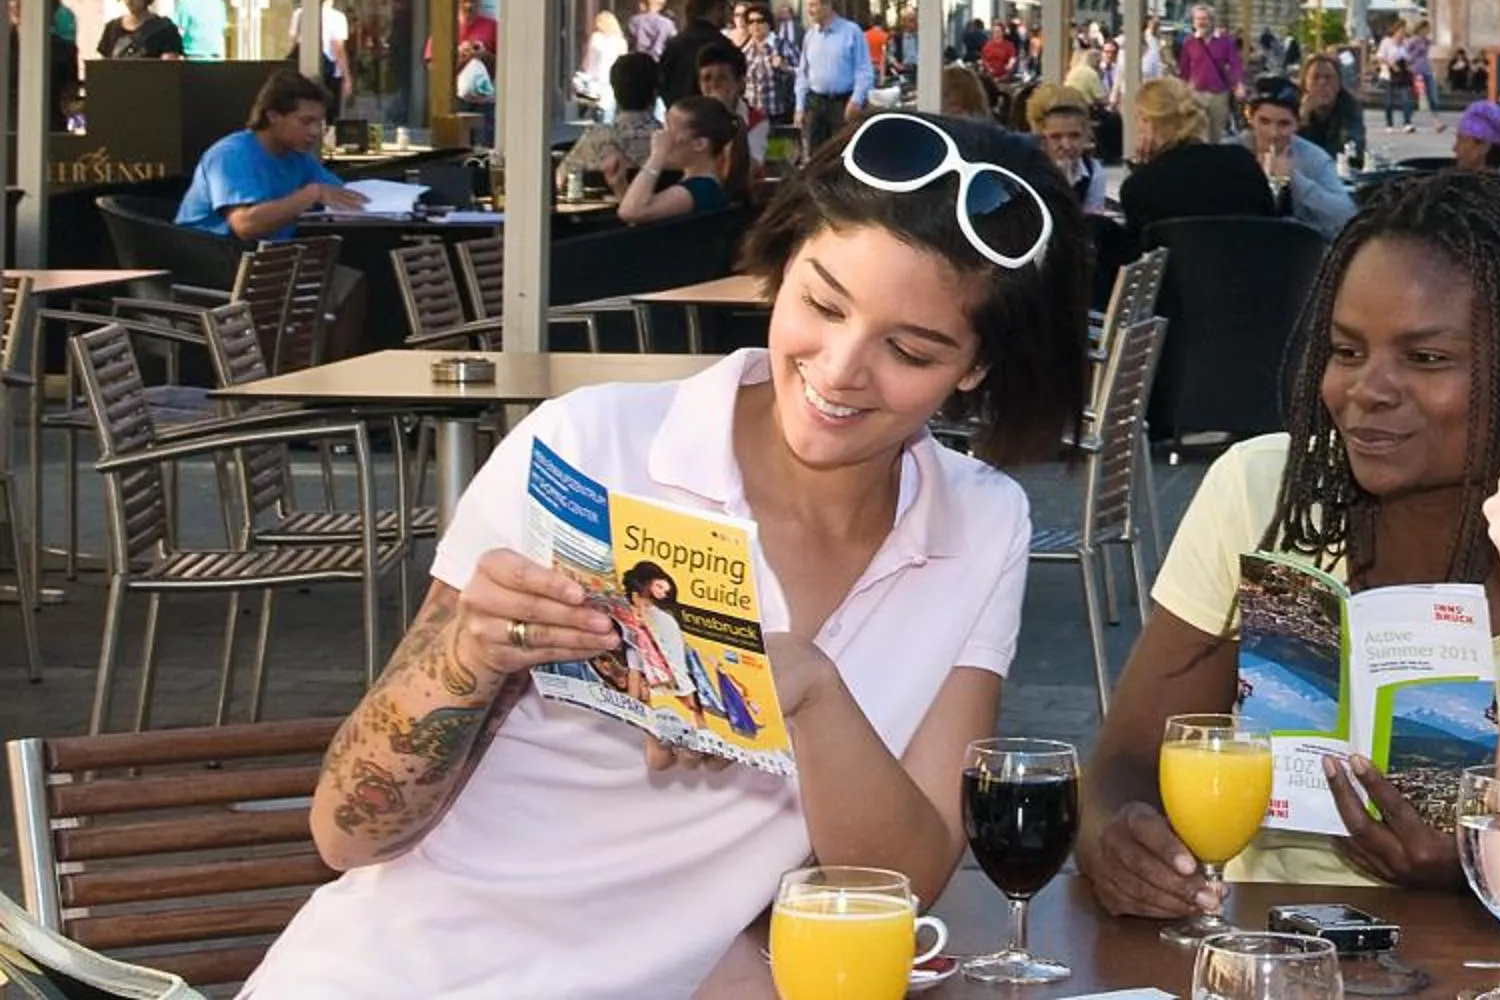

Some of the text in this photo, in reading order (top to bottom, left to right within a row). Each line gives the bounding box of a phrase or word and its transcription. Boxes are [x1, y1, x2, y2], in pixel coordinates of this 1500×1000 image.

[623, 524, 746, 585] Shopping
[689, 579, 752, 611] Guide
[1365, 645, 1434, 660] Summer
